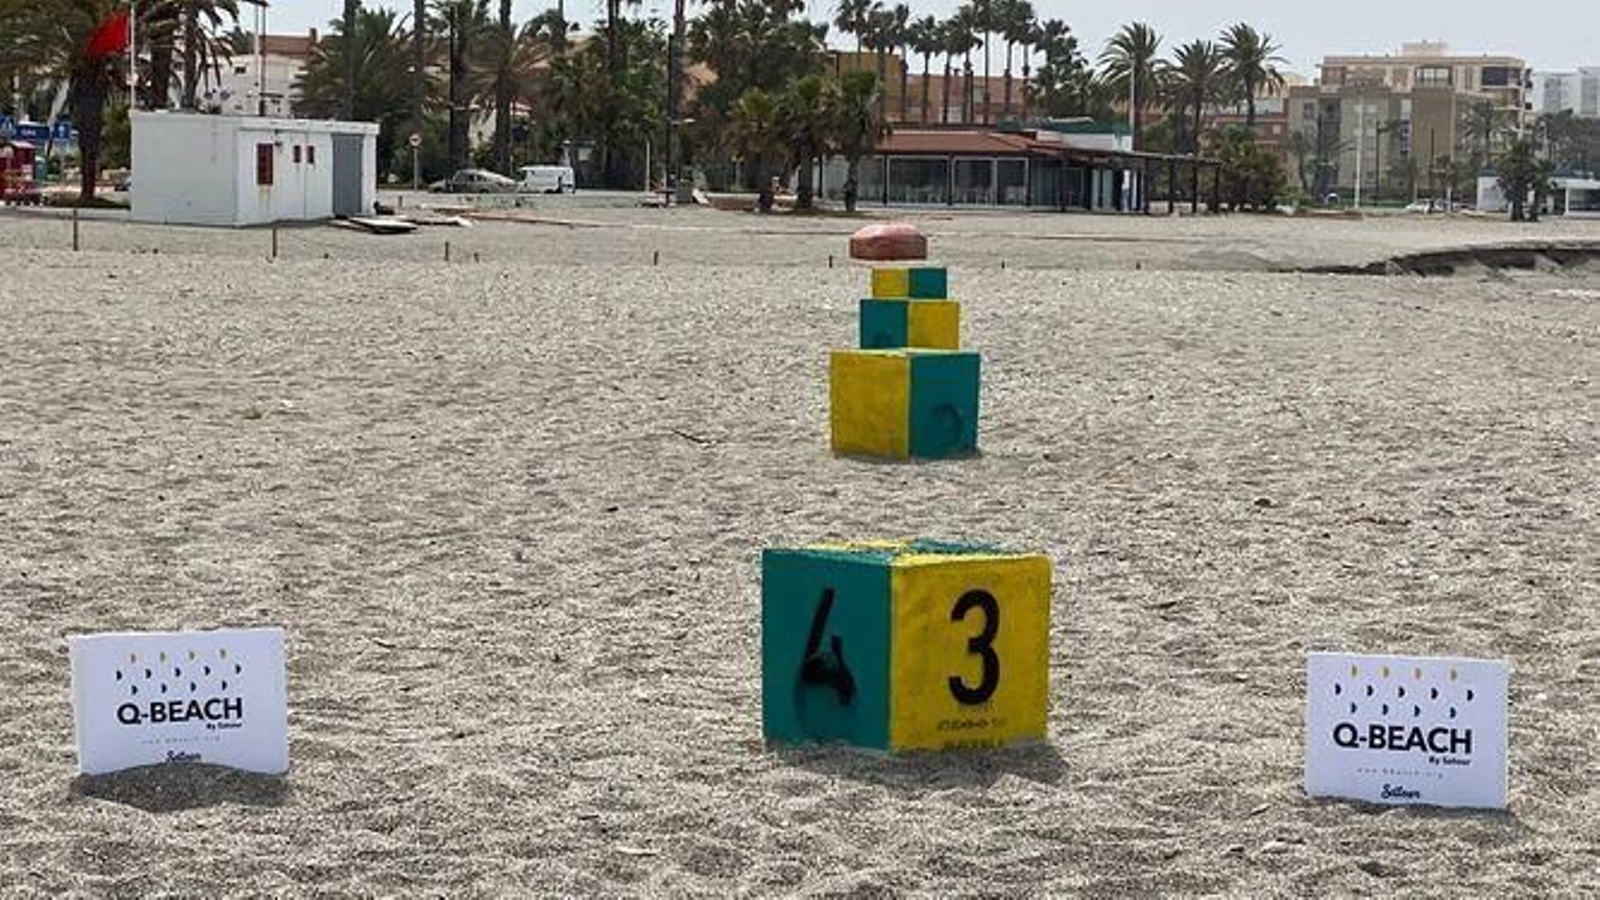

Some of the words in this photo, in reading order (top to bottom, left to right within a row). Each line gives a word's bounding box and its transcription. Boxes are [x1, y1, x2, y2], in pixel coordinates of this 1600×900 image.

[949, 589, 1000, 706] 3
[117, 698, 243, 725] Q-BEACH
[1333, 723, 1472, 754] Q-BEACH
[1429, 756, 1440, 765] By
